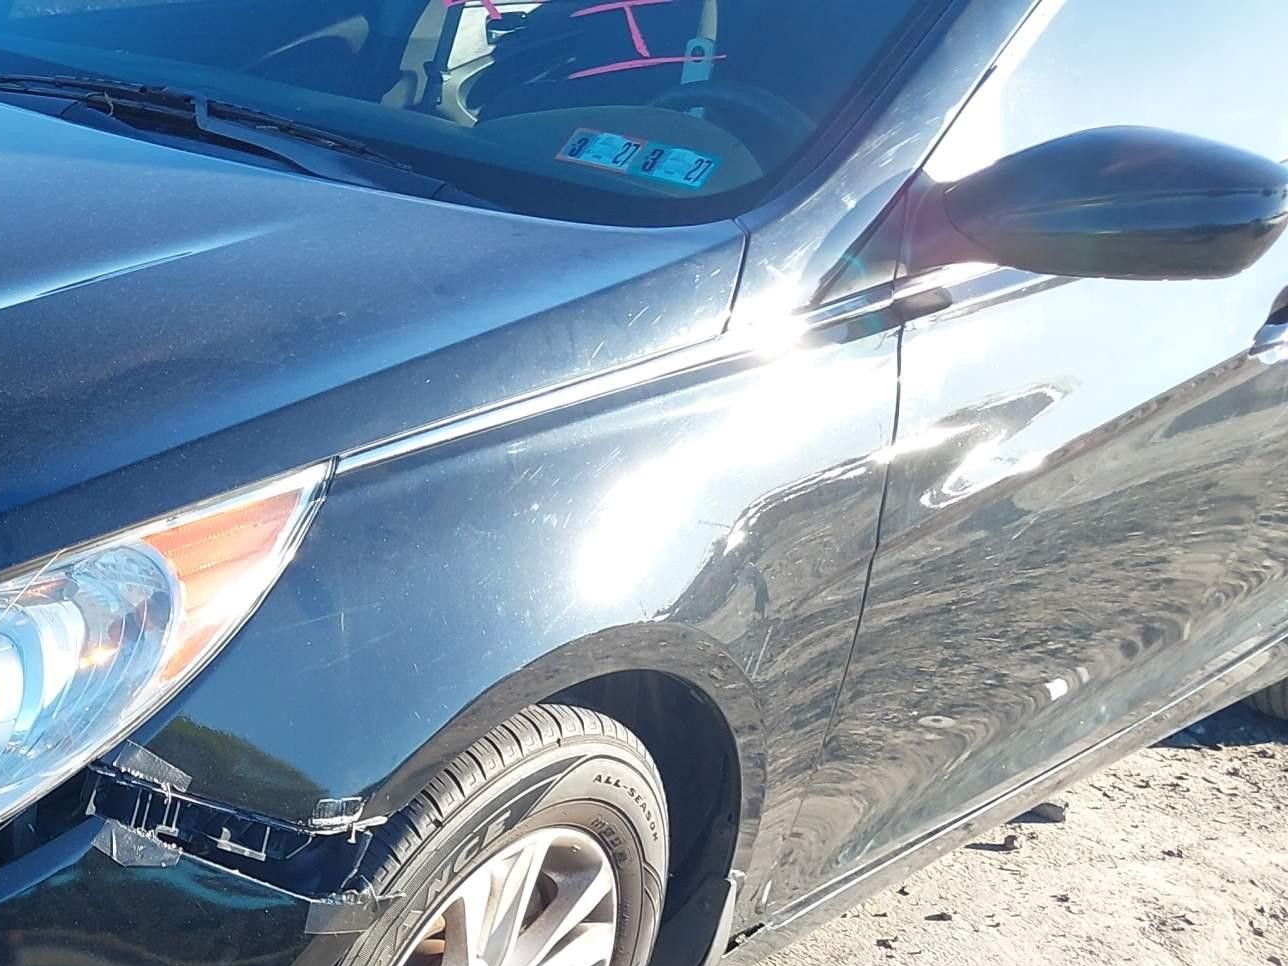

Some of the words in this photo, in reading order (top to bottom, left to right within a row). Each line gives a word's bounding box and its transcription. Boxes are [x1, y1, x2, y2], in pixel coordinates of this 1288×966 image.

[568, 137, 590, 158] 3
[612, 141, 641, 168] 27
[641, 148, 665, 172] 3
[684, 157, 713, 184] 27
[592, 774, 659, 842] ALL-SEASON
